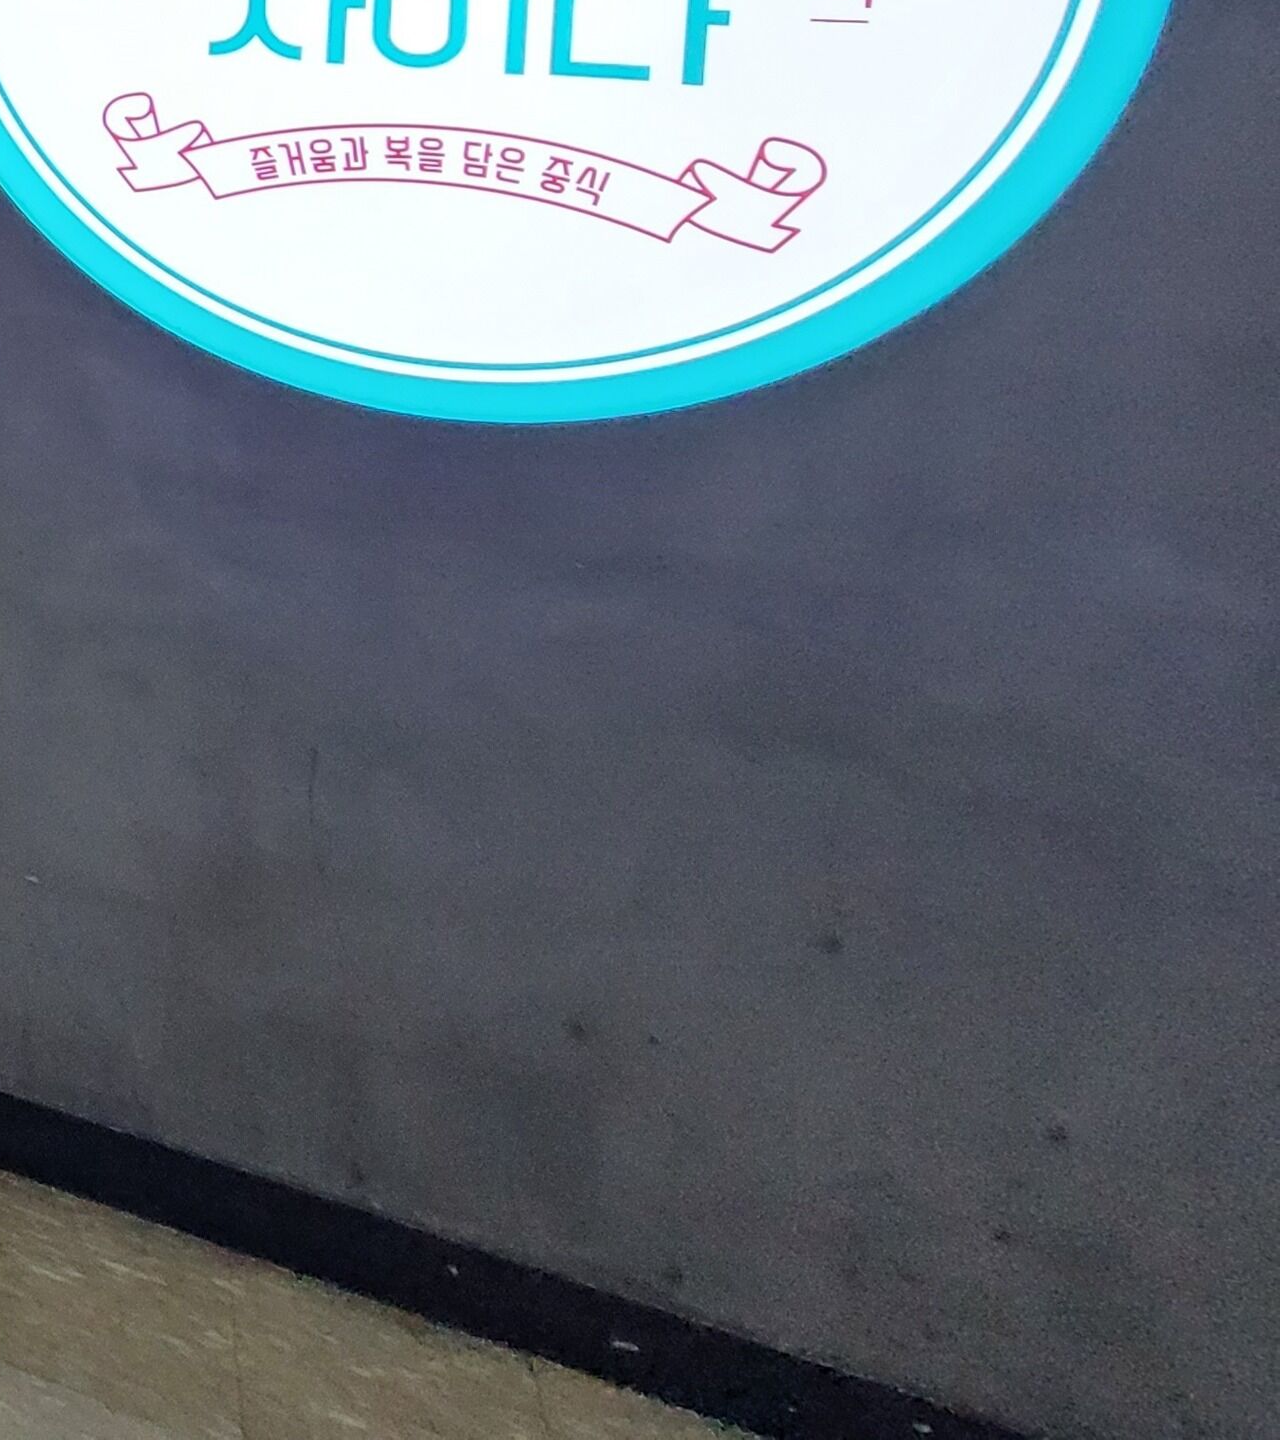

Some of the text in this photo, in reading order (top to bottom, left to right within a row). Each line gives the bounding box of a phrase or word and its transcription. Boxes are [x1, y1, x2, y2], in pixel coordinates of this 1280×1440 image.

[249, 136, 613, 207] 즐거움과 복을 담은 중식
